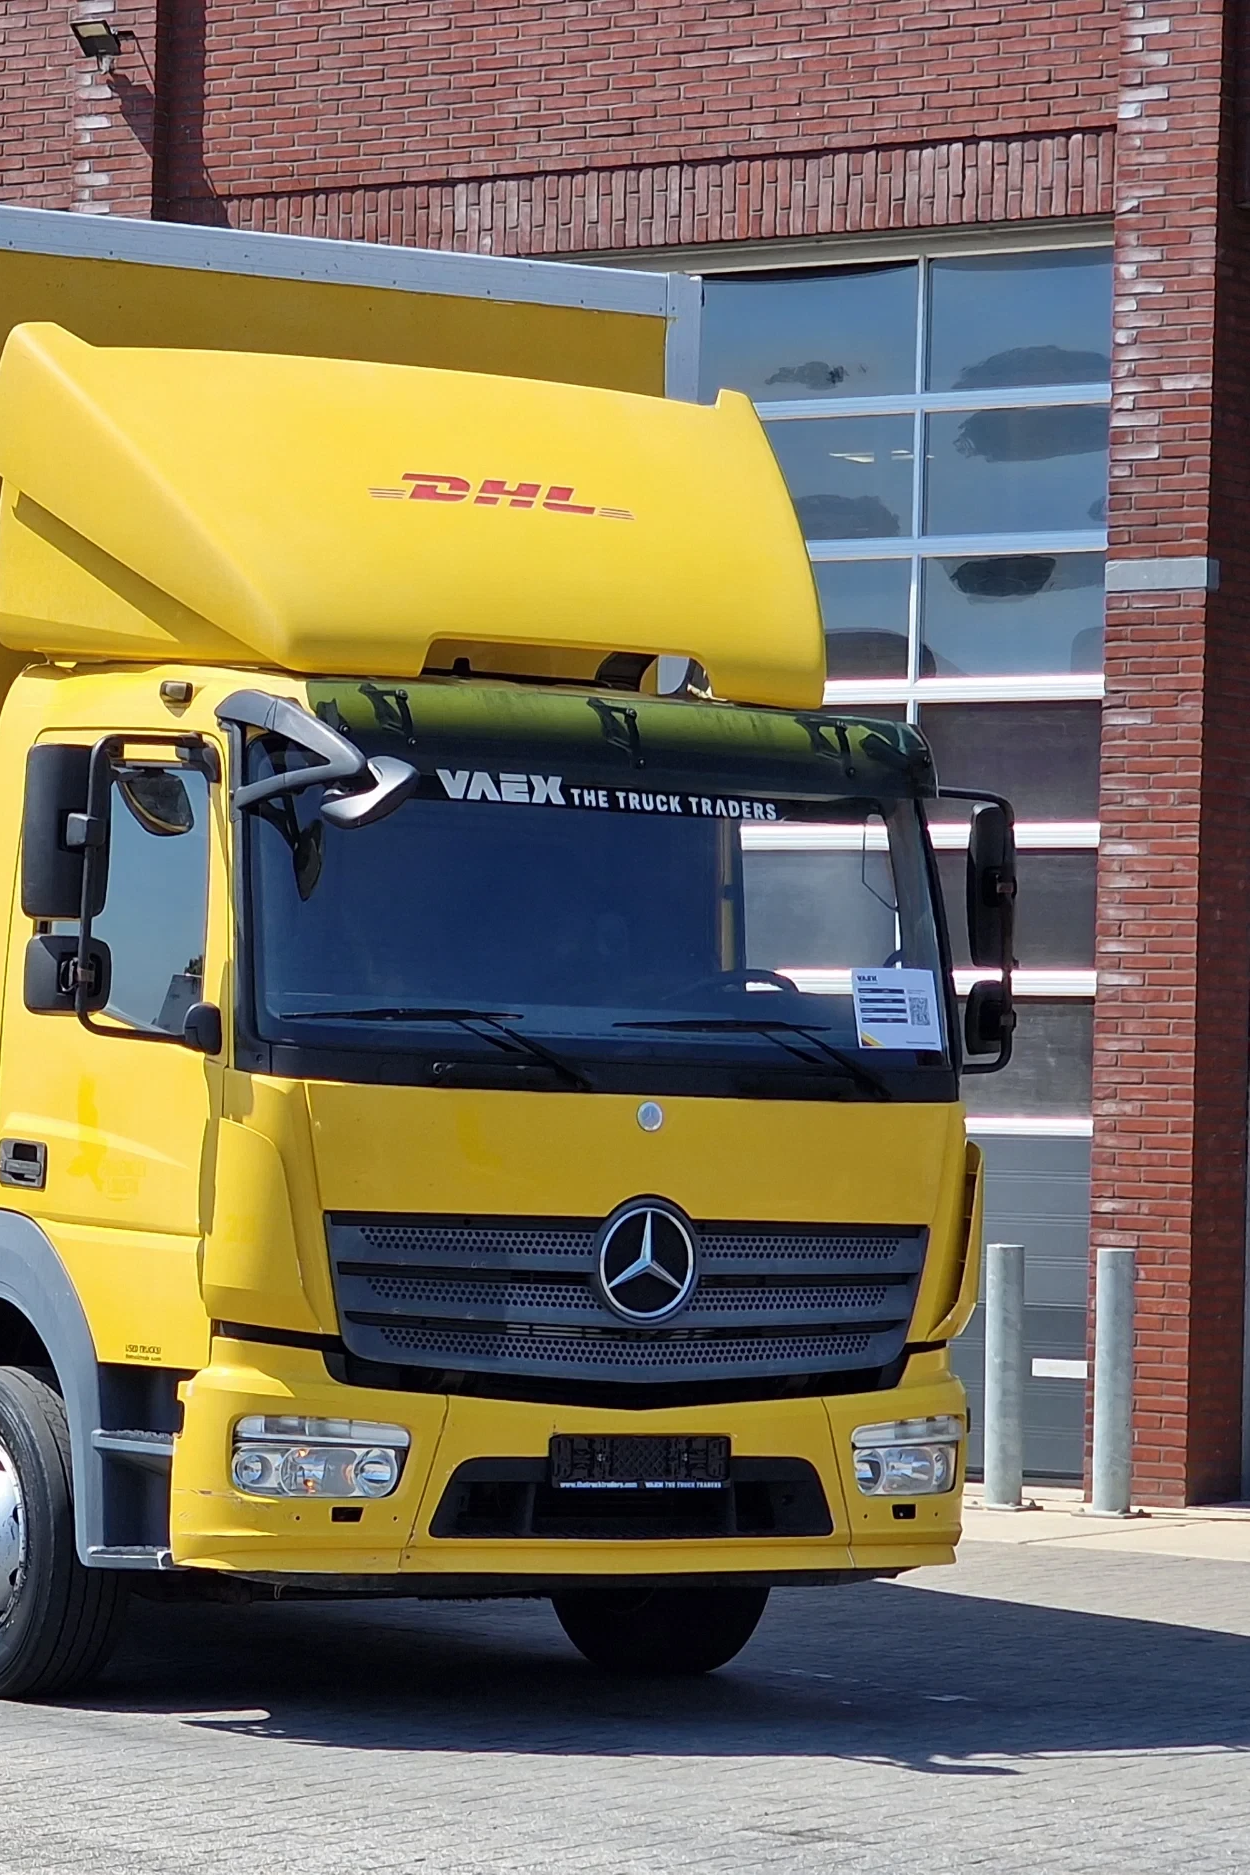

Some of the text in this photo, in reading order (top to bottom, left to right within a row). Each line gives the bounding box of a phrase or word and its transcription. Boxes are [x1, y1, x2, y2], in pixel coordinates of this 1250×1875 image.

[401, 473, 596, 515] DHL
[436, 769, 777, 821] VAEX THE TRUCK TRADERS
